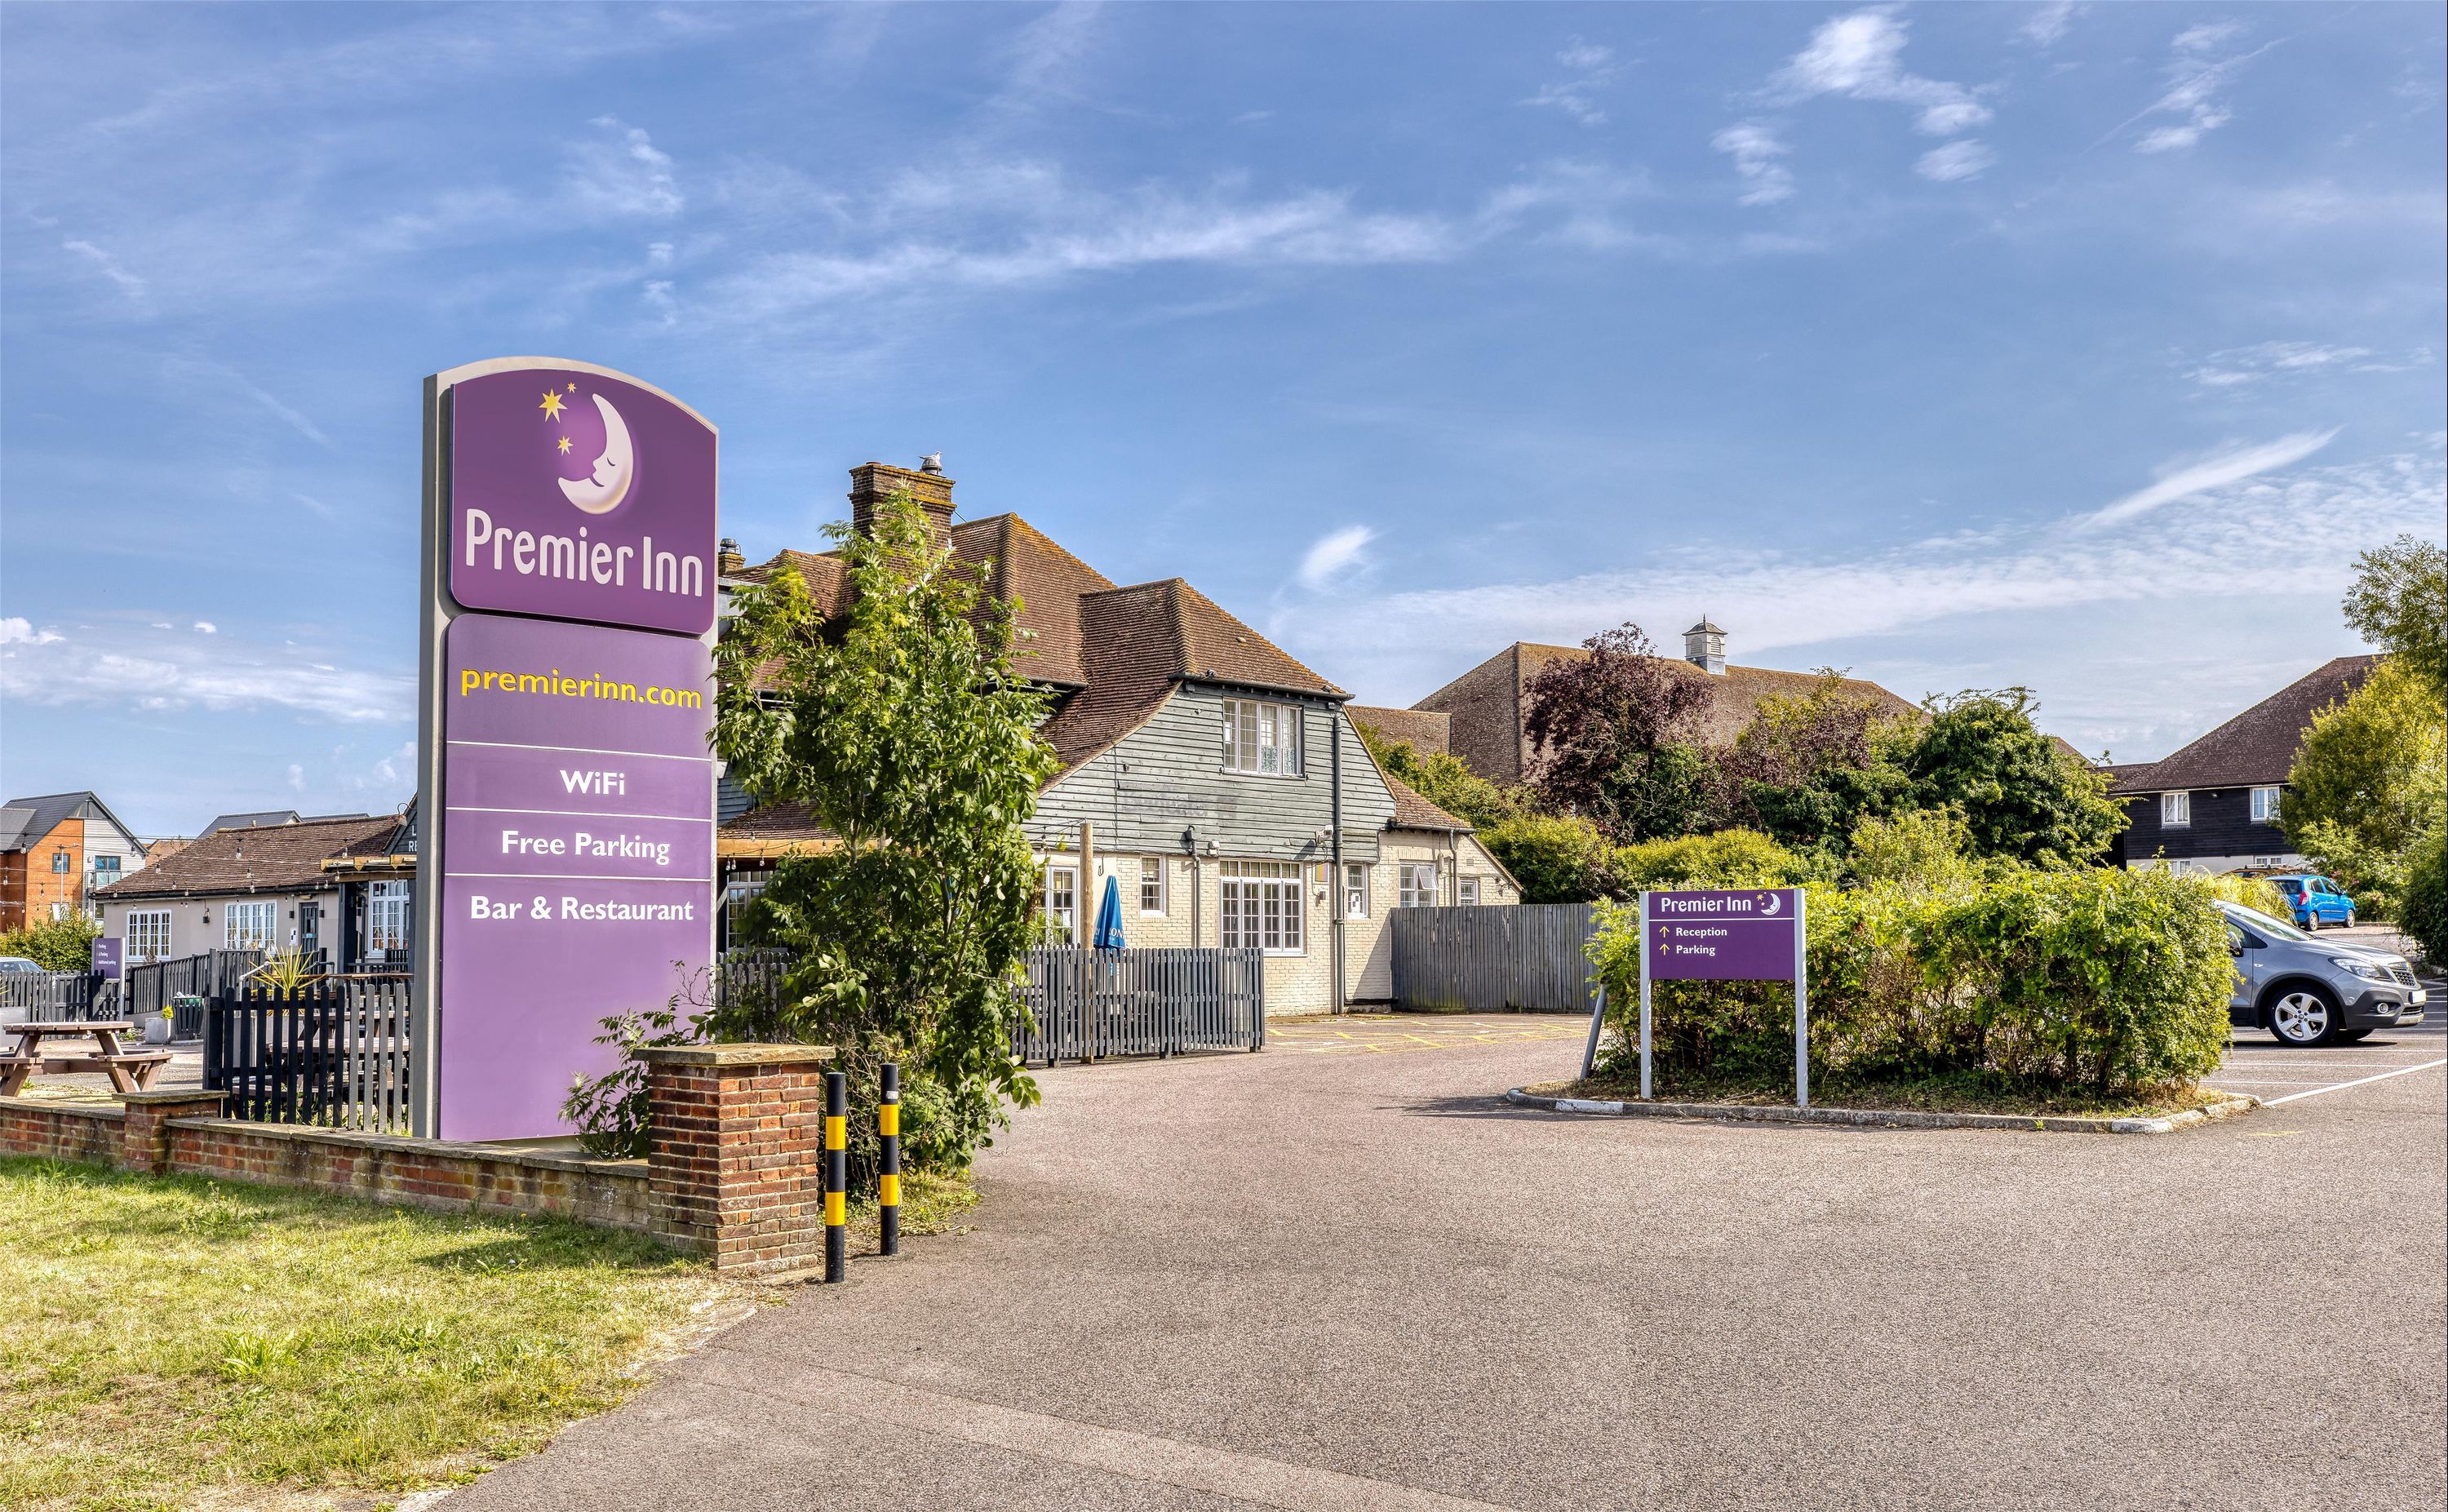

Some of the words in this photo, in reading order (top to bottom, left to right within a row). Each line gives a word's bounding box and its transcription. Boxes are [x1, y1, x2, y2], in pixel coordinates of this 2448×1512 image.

[466, 508, 633, 586] Premier
[643, 535, 703, 597] Inn
[461, 667, 703, 709] premierinn.com
[559, 769, 625, 796] WiFi
[502, 830, 565, 855] Free
[574, 832, 671, 866] Parking
[471, 895, 523, 920] Bar
[530, 896, 552, 920] &
[561, 896, 694, 920] Restaurant
[1661, 897, 1723, 912] Premier
[1727, 896, 1752, 911] Inn
[1675, 927, 1727, 938] Reception
[1676, 945, 1716, 956] Parking
